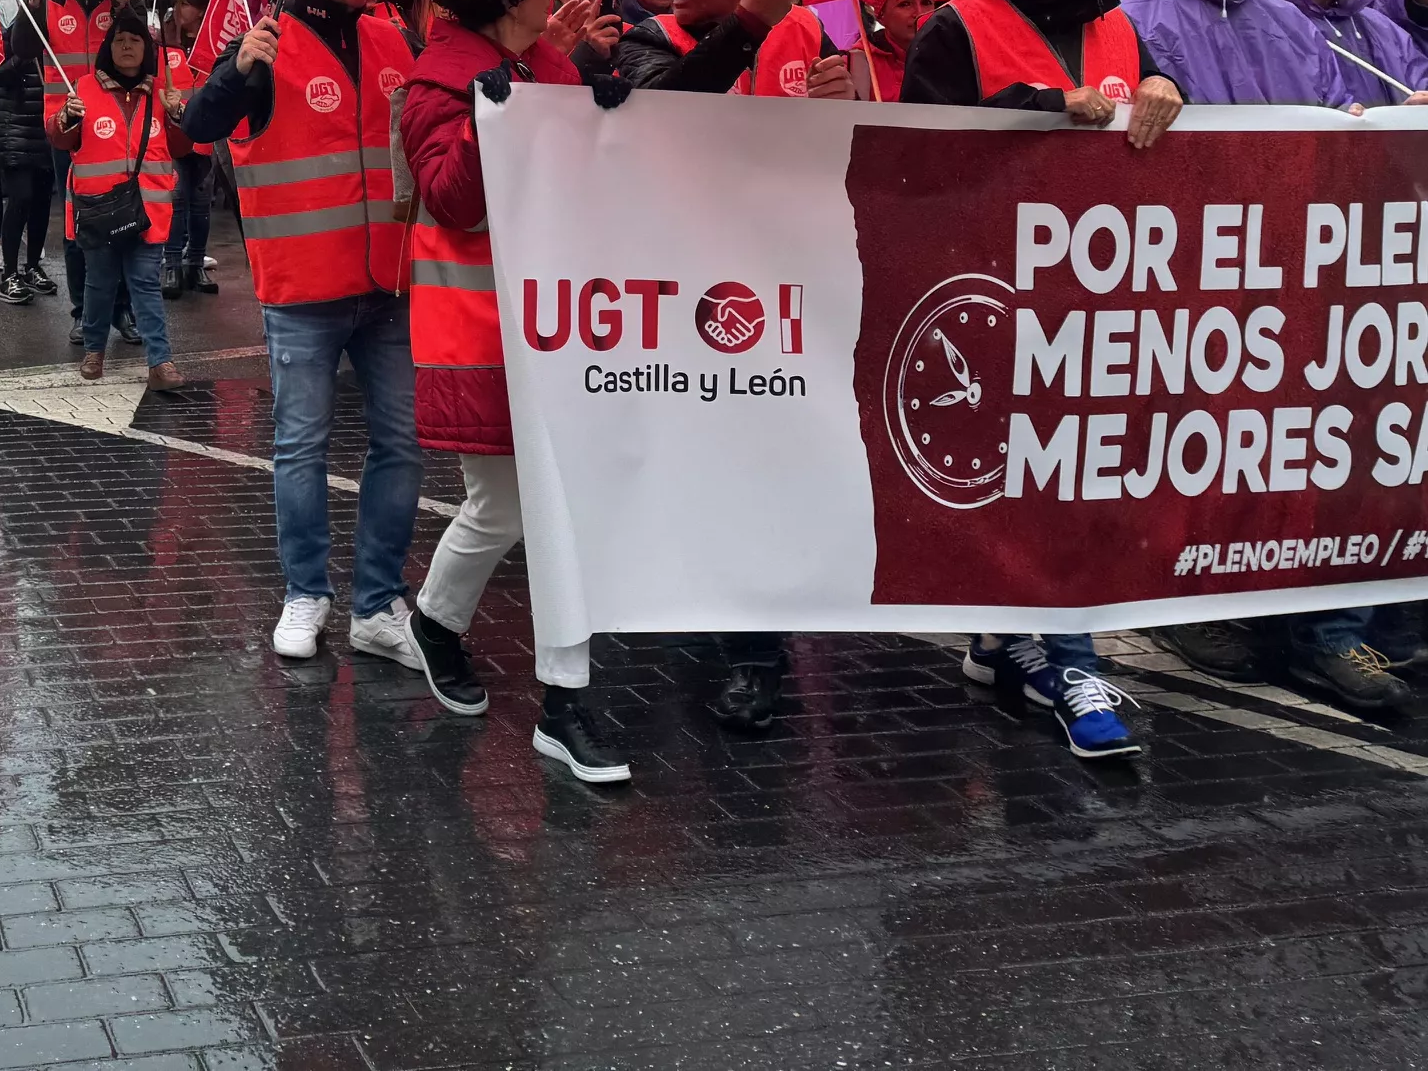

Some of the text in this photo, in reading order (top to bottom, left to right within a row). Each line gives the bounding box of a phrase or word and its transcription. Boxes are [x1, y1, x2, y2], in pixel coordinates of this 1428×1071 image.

[310, 81, 336, 98] UGT
[381, 73, 401, 87] UGT
[1103, 83, 1127, 99] UGT
[96, 119, 112, 131] UGT
[1015, 202, 1178, 295] POR
[1199, 204, 1283, 291] EL
[523, 278, 679, 352] UGT
[1012, 305, 1286, 397] MENOS
[584, 364, 807, 402] Castilla y León
[1004, 404, 1354, 502] MEJORES
[1174, 533, 1380, 576] #PLENOEMPLEO
